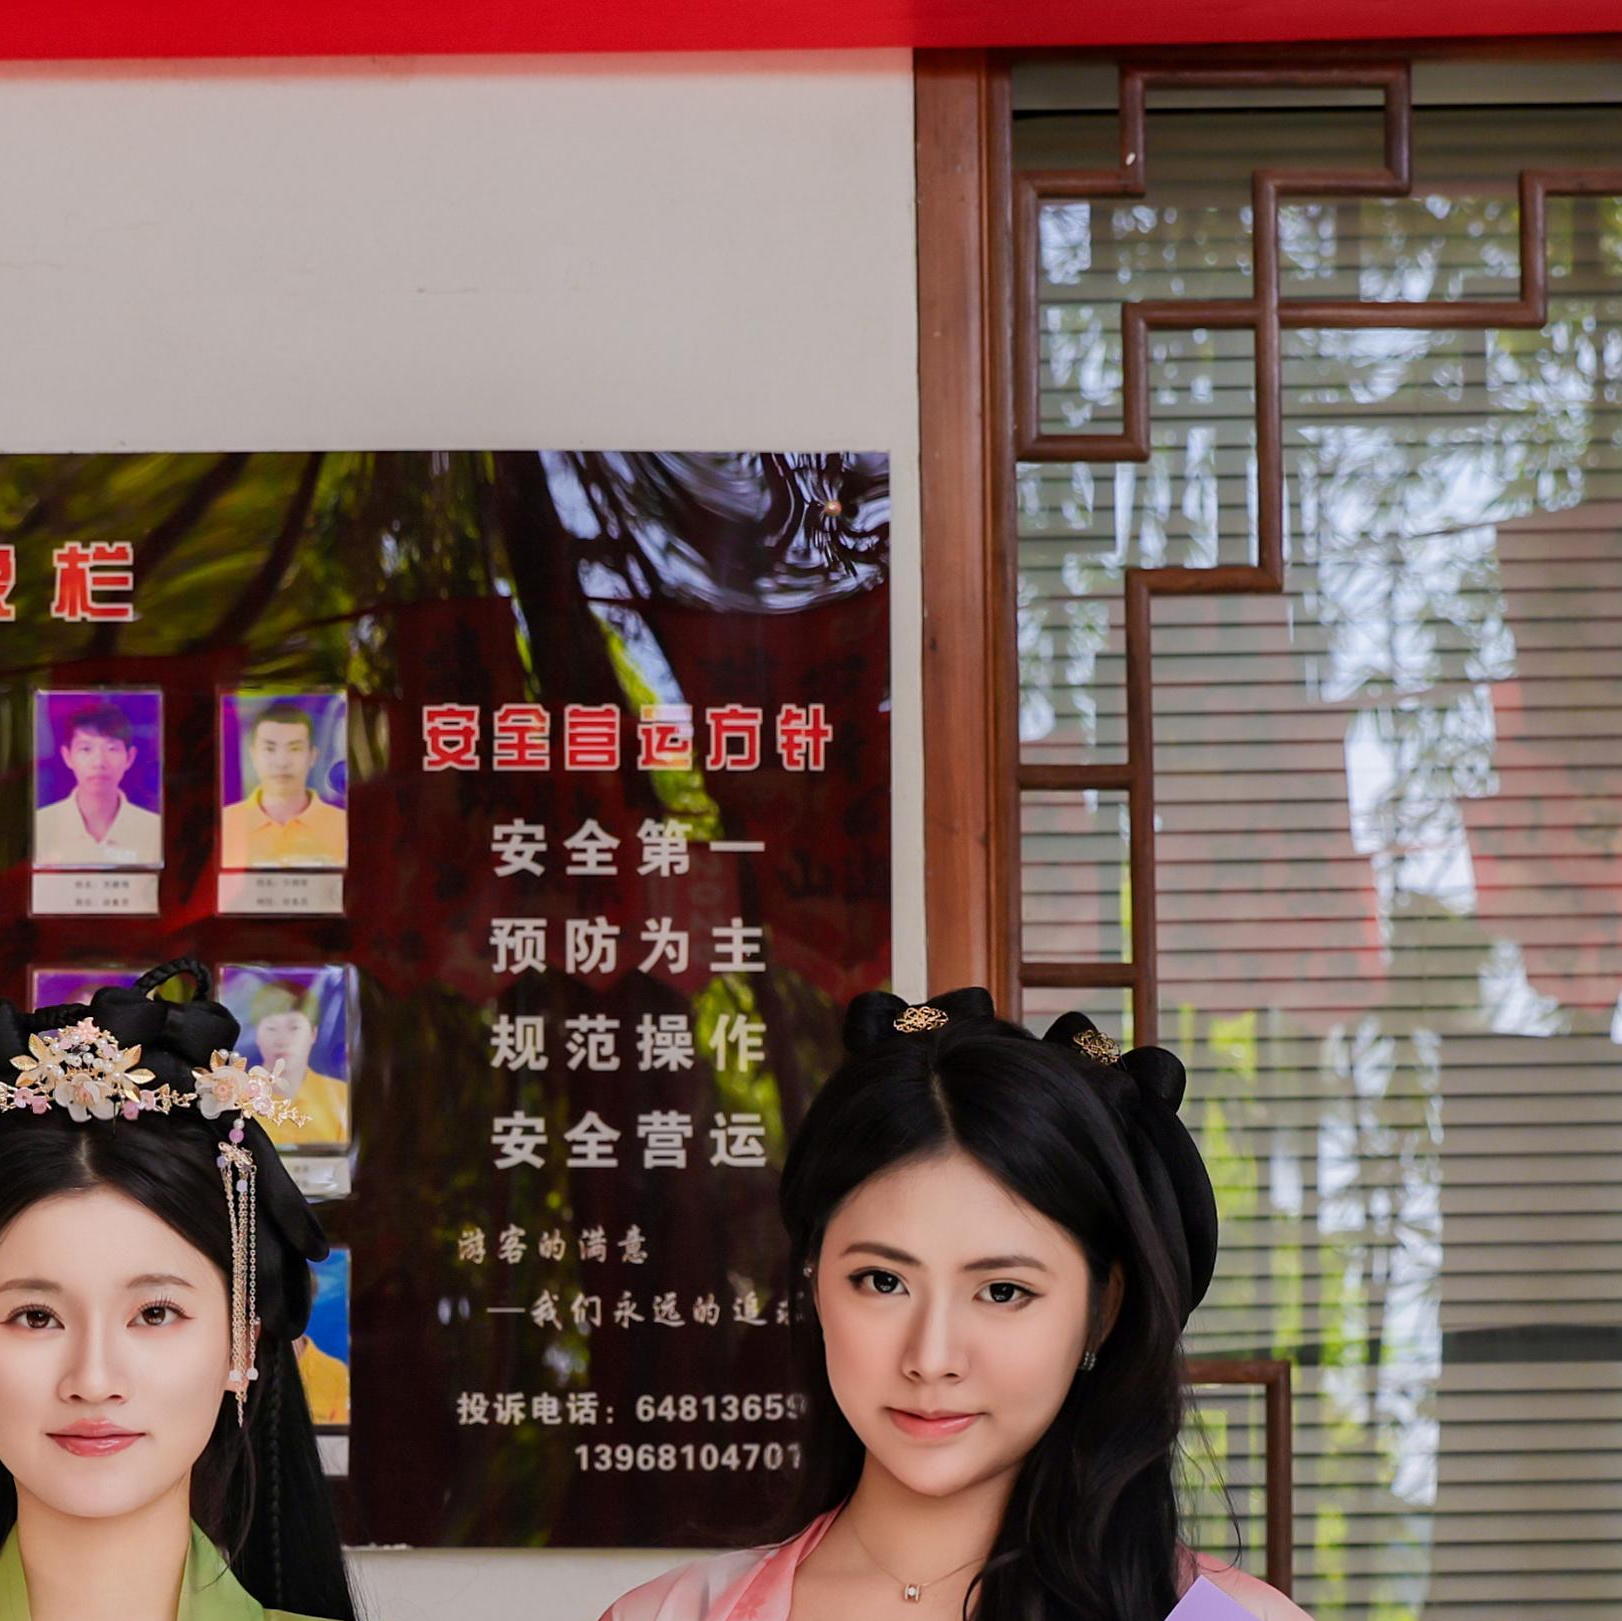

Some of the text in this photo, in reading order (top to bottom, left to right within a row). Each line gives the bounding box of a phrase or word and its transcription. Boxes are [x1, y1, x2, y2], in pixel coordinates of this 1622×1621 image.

[422, 703, 833, 771] 安全营运方针
[491, 818, 766, 878] 安全第一
[489, 917, 766, 974] 预防为主
[490, 1014, 766, 1072] 规范操作
[491, 1110, 767, 1169] 安全营运
[457, 1223, 649, 1265] 游客的满意
